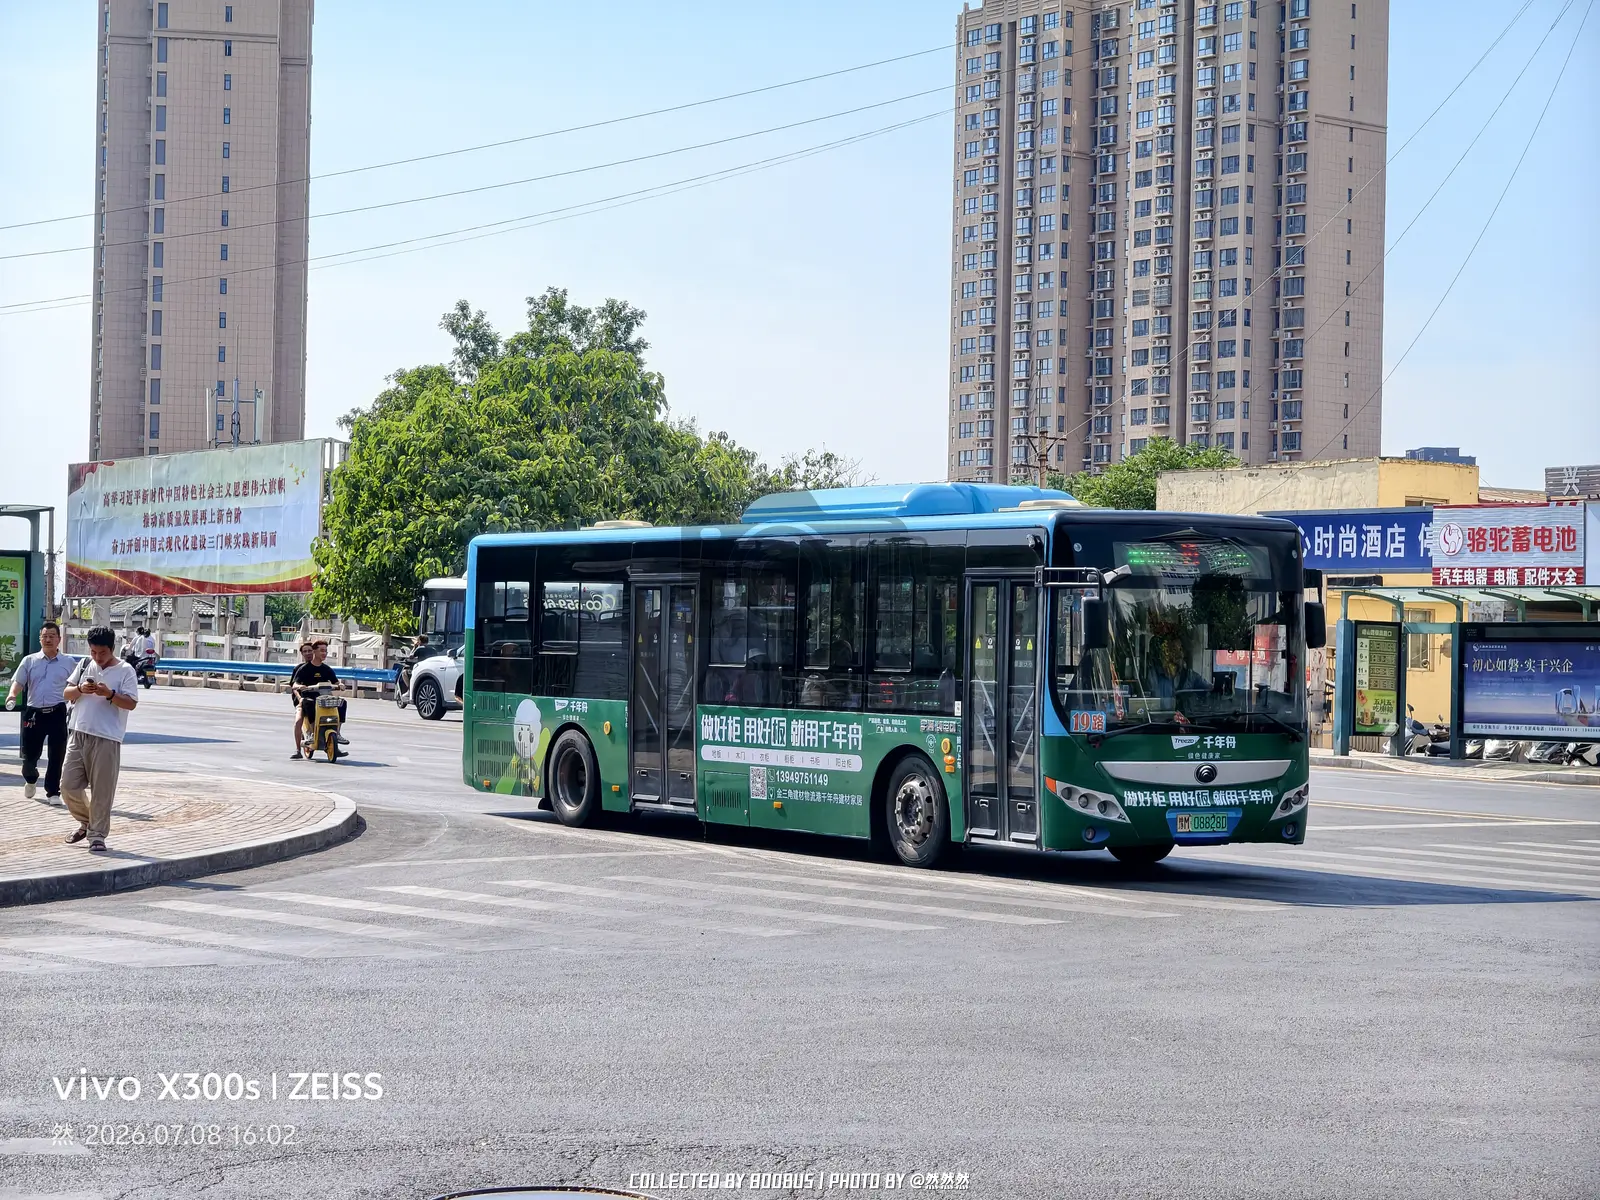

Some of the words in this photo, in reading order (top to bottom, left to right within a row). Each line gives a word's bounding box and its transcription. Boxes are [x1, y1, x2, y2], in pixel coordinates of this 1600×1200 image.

[1562, 466, 1580, 496] 兴
[142, 507, 242, 529] 推动高质量发展再上新台阶
[111, 530, 278, 555] 奋力开创中国式现代化建设三门峡实践新局面
[1467, 525, 1577, 553] 骆驼蓄电池
[1439, 568, 1488, 585] 汽车电器
[1493, 568, 1519, 585] 电瓶
[1524, 568, 1578, 585] 配件大全
[1472, 657, 1573, 673] 初心如磐·实干兴企
[1072, 711, 1105, 732] 19路
[701, 714, 741, 743] 做好柜
[791, 719, 863, 751] 就用千年舟
[1203, 735, 1237, 749] 千年舟
[776, 770, 829, 786] 13949751149
[1124, 790, 1167, 807] 做好柜
[1213, 789, 1274, 806] 就用千年舟
